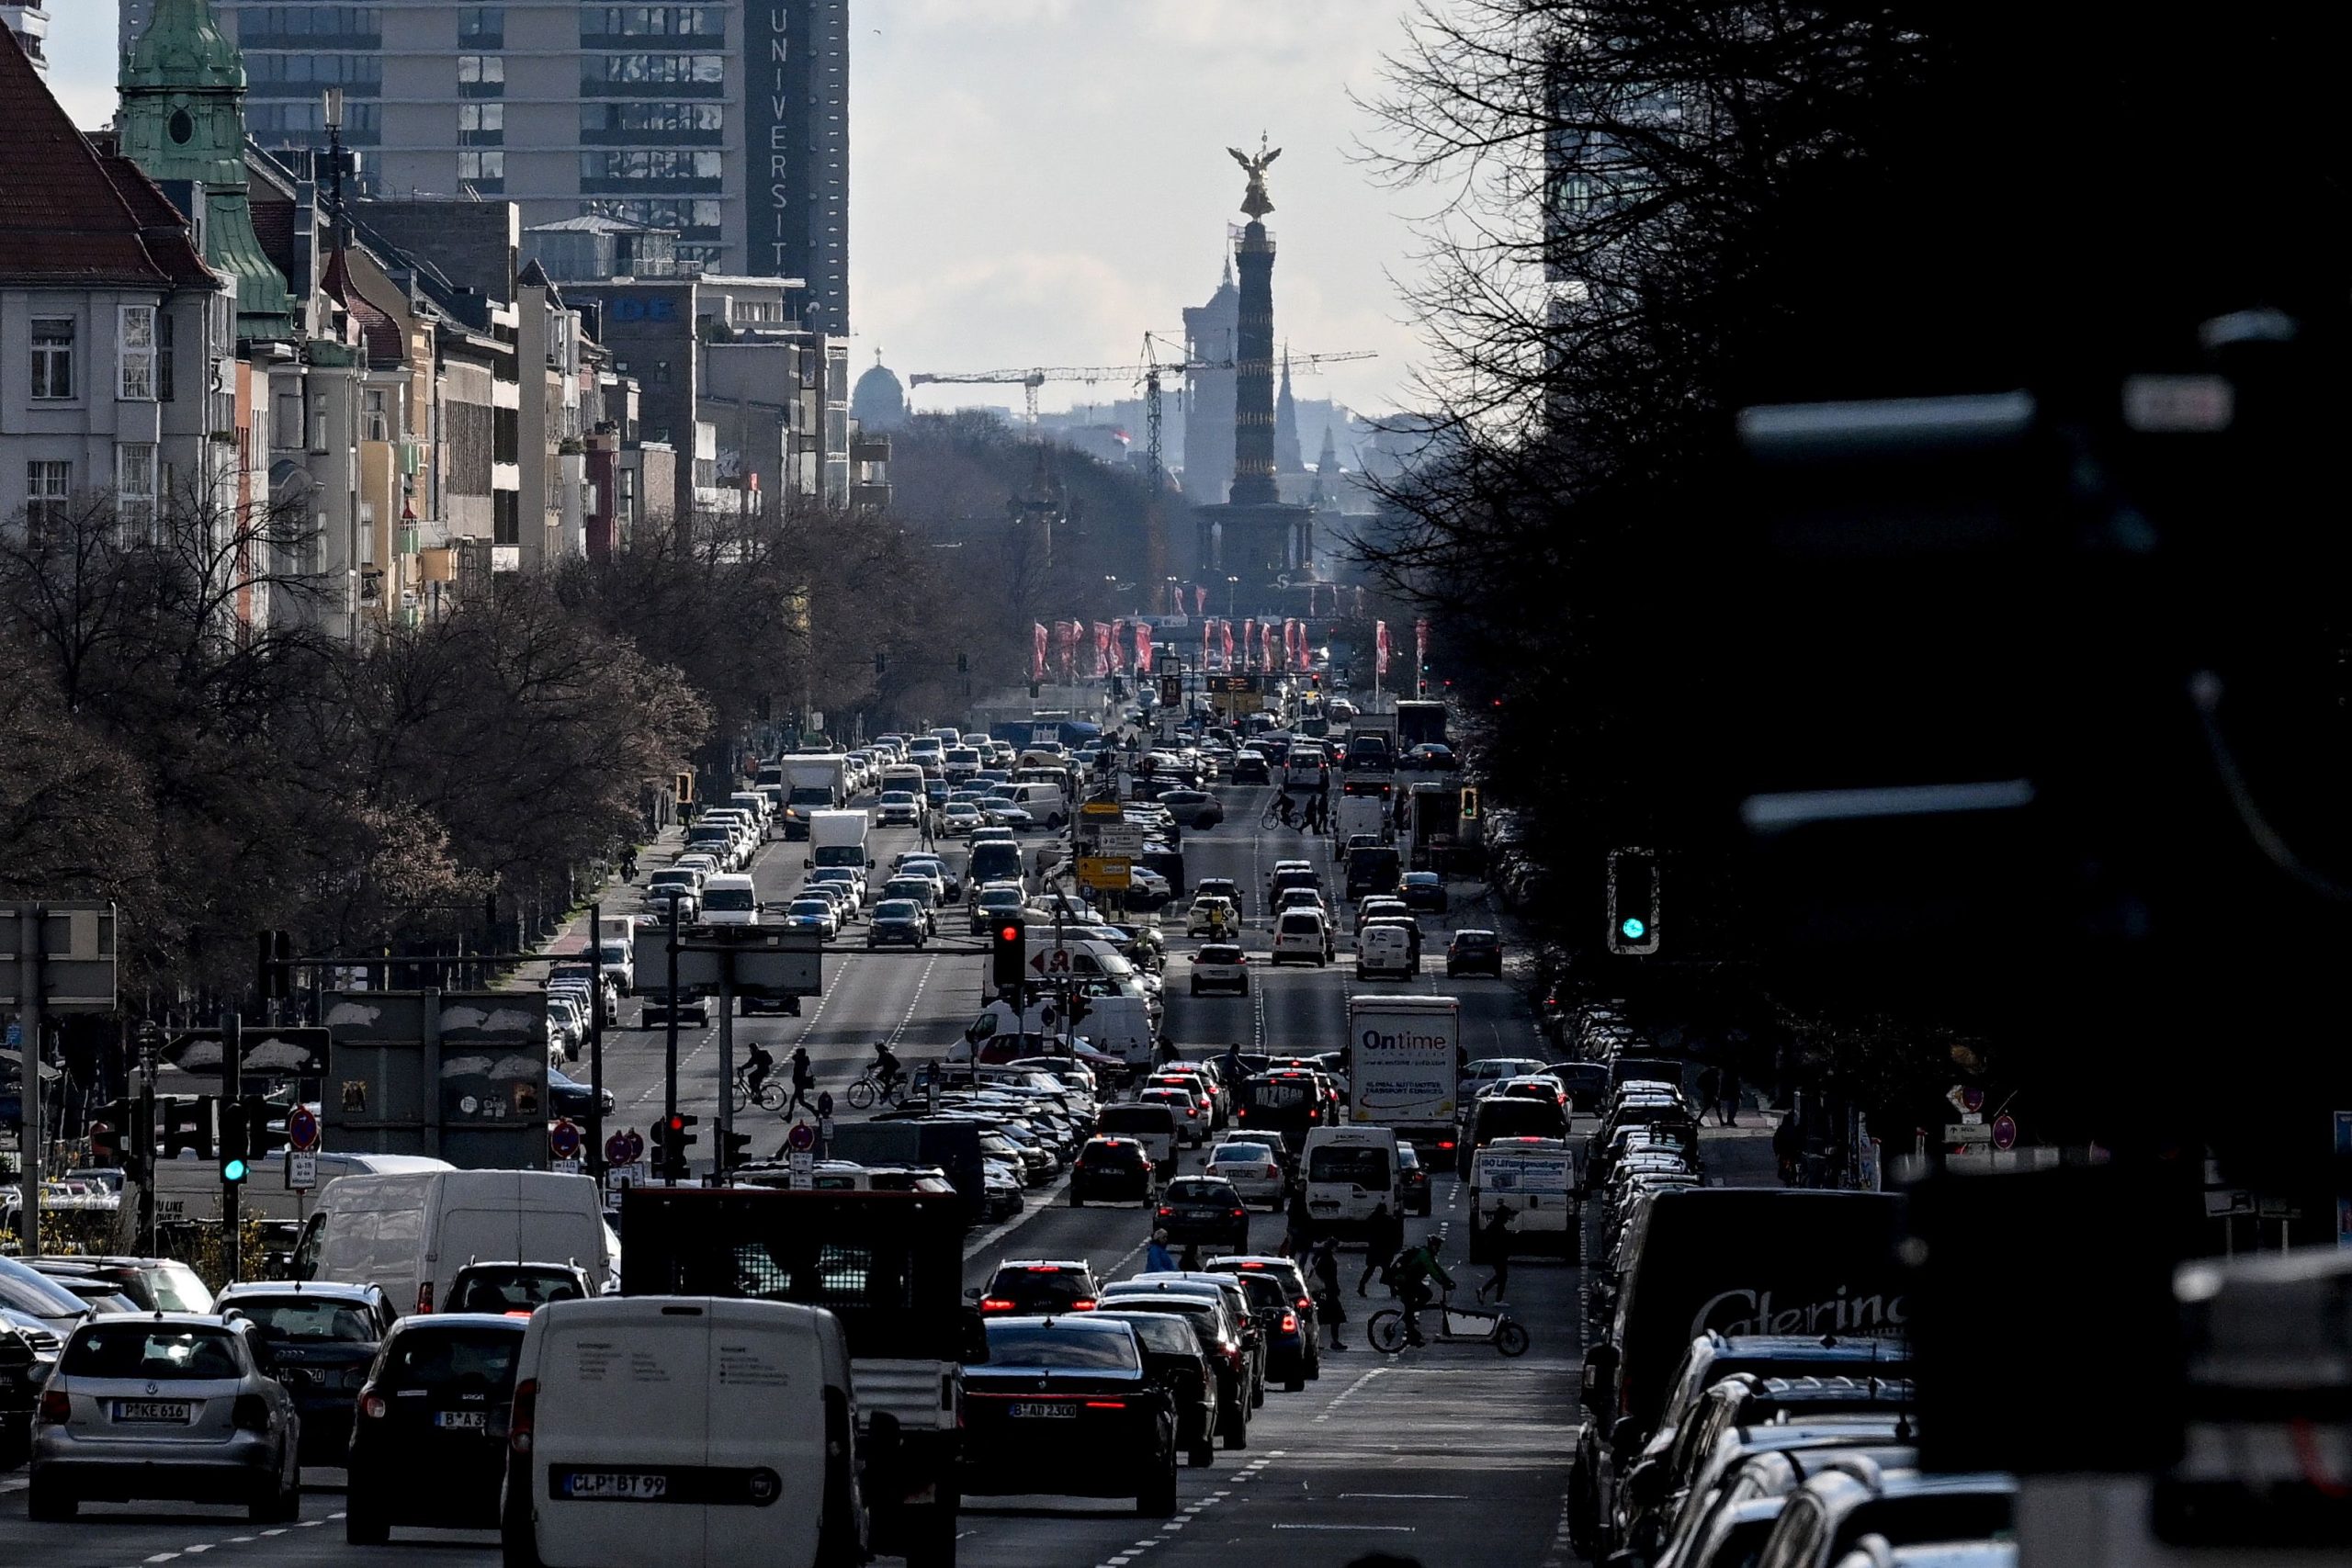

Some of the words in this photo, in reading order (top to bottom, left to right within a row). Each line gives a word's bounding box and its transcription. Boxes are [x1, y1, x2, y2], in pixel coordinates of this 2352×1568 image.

[772, 8, 787, 276] UNIVERSIT
[1363, 1030, 1446, 1049] Ontime
[165, 1201, 184, 1213] LIKE
[126, 1404, 133, 1416] P
[141, 1404, 157, 1416] KE
[161, 1404, 184, 1417] 616
[573, 1475, 606, 1491] CLP
[616, 1475, 640, 1492] BT
[643, 1476, 665, 1493] 99
